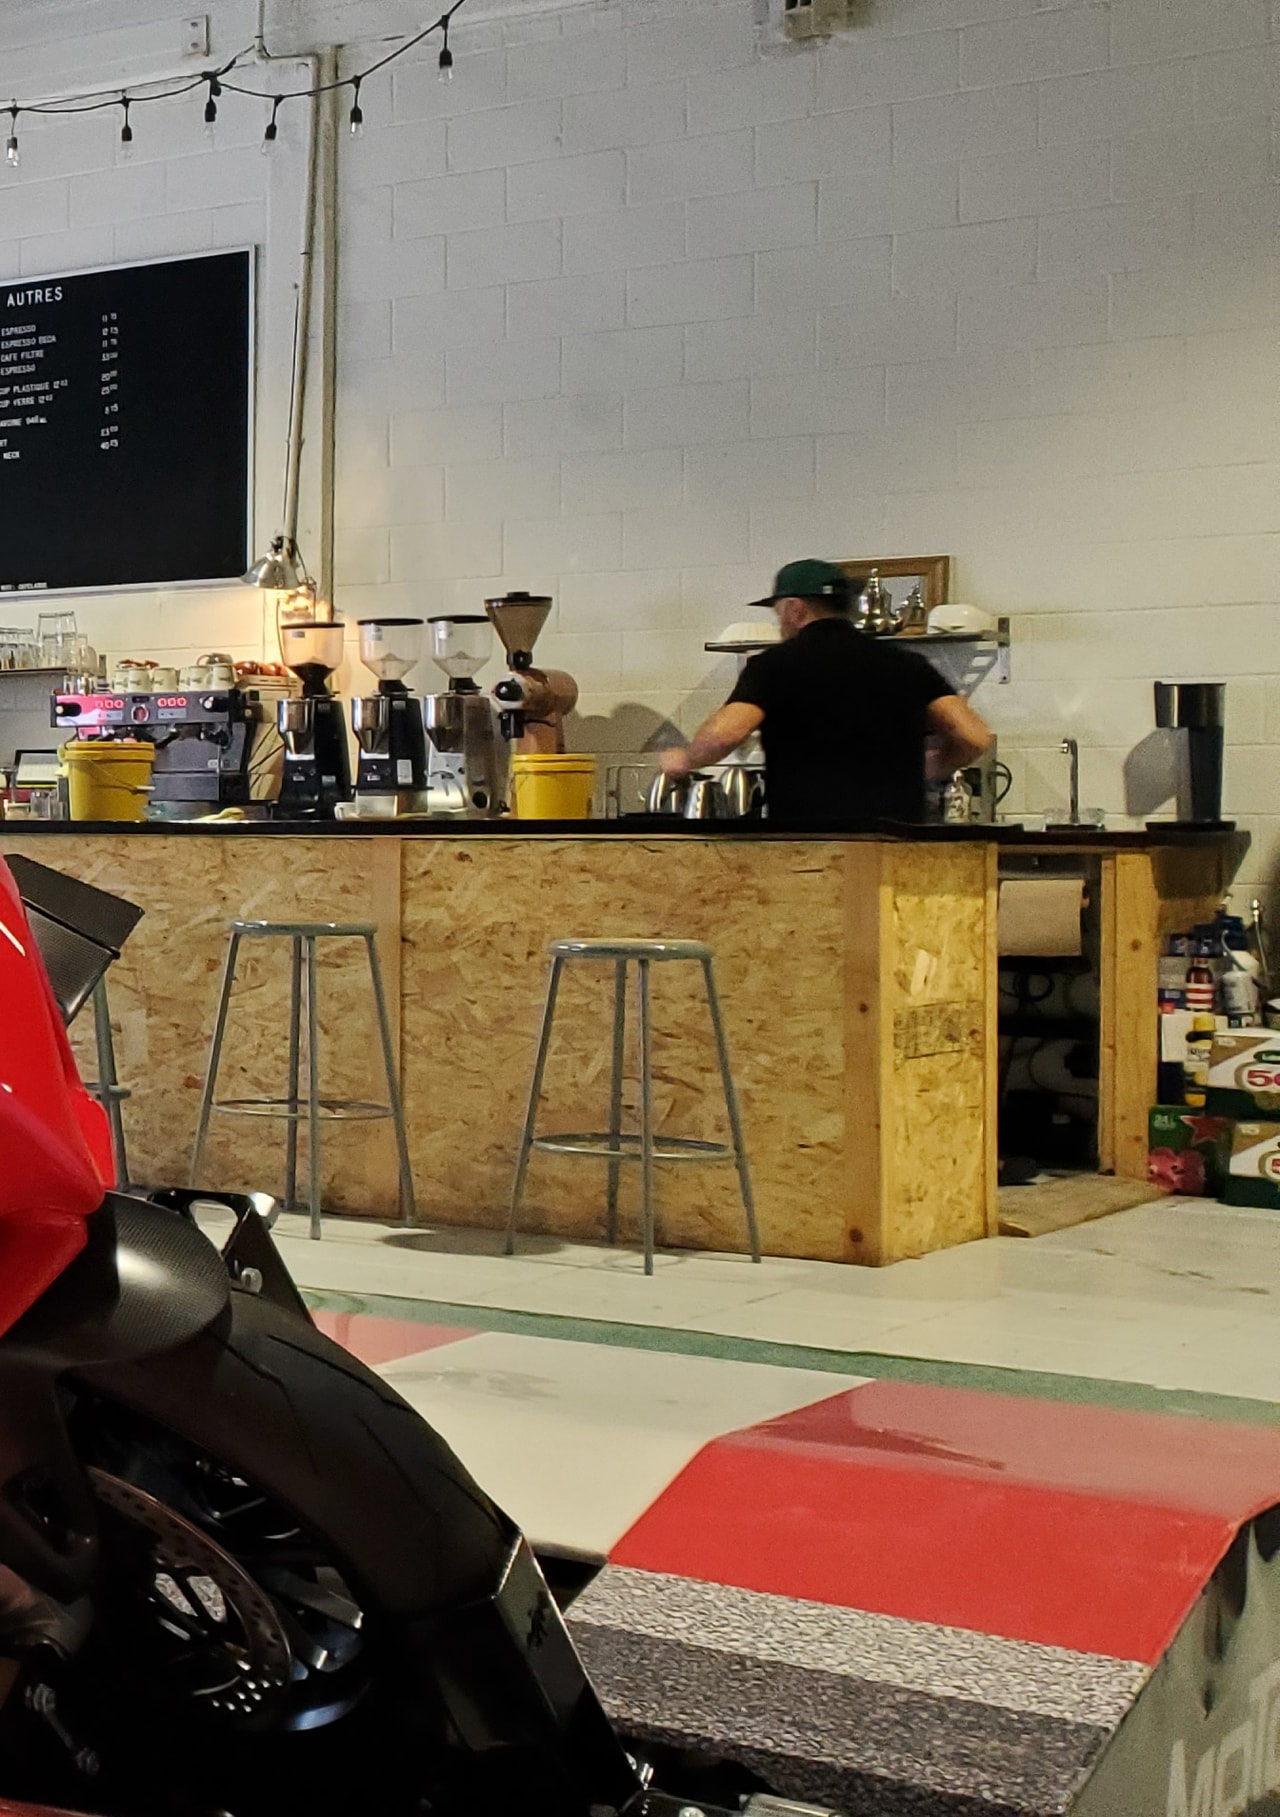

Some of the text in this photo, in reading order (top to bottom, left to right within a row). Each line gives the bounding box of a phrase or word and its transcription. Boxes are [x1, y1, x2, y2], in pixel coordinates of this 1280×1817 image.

[7, 286, 63, 308] AUTRES
[1, 324, 37, 337] ESPRESSO
[1, 338, 37, 350] ESPRESSO
[21, 349, 44, 359] FILTRE
[0, 364, 36, 376] ESPRESSO
